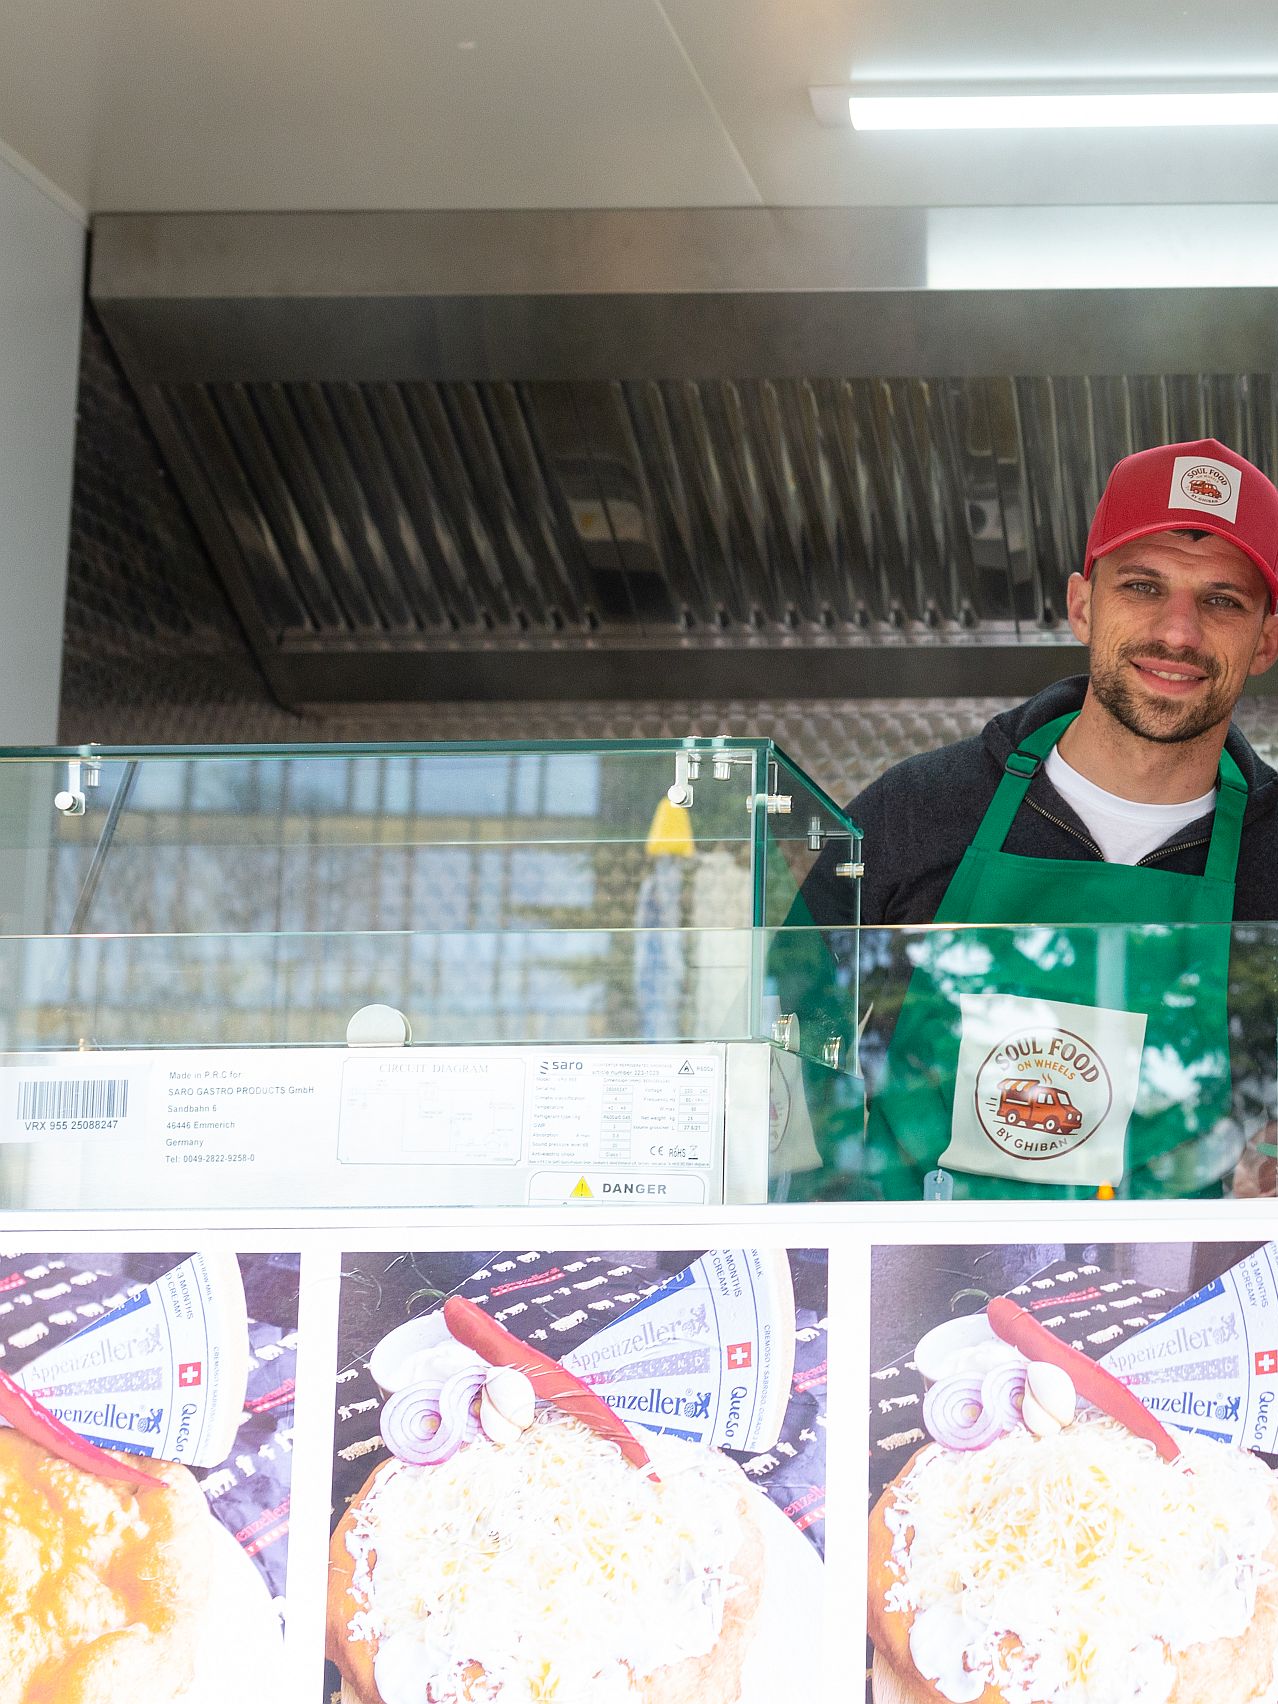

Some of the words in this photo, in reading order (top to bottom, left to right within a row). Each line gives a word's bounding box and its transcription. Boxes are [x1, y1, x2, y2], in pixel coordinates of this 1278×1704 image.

[1187, 468, 1208, 479] SOUL
[1209, 469, 1228, 486] FOOD
[169, 1071, 192, 1080] Made
[194, 1072, 202, 1080] in
[229, 1070, 242, 1079] for
[379, 1063, 425, 1073] CIRCUIT
[432, 1063, 489, 1073] DIAGRAM
[552, 1061, 584, 1070] saro
[995, 1036, 1043, 1071] SOUL
[1048, 1037, 1100, 1083] FOOD
[1017, 1058, 1033, 1072] ON
[1034, 1058, 1077, 1081] WHEELS
[167, 1104, 210, 1113] Sandbahn
[168, 1087, 194, 1096] SARO
[196, 1086, 234, 1096] GASTRO
[236, 1086, 286, 1095] PRODUCTS
[288, 1085, 314, 1095] GmbH
[25, 1120, 47, 1131] VRX
[50, 1120, 68, 1131] 955
[71, 1120, 119, 1131] 25088247
[165, 1138, 205, 1148] Germany
[166, 1121, 192, 1130] 46446
[193, 1121, 236, 1130] Emmerich
[996, 1127, 1013, 1142] BY
[1014, 1137, 1069, 1152] GHIBAN
[603, 1183, 667, 1195] DANGER
[712, 1257, 730, 1297] CREAMY
[725, 1255, 743, 1297] MONTHS
[1241, 1271, 1257, 1308] CREAMY
[1253, 1267, 1269, 1308] MONTHS
[167, 1281, 182, 1319] CREAMY
[179, 1279, 194, 1320] MONTHS
[31, 1338, 137, 1383] Appenzeller
[570, 1321, 681, 1370] Appenzeller
[763, 1324, 771, 1363] CREMOSO
[1109, 1327, 1213, 1372] Appenzeller
[725, 1386, 747, 1437] Queso
[1137, 1392, 1218, 1418] enzeller
[1254, 1391, 1275, 1440] Queso
[176, 1403, 197, 1453] Queso
